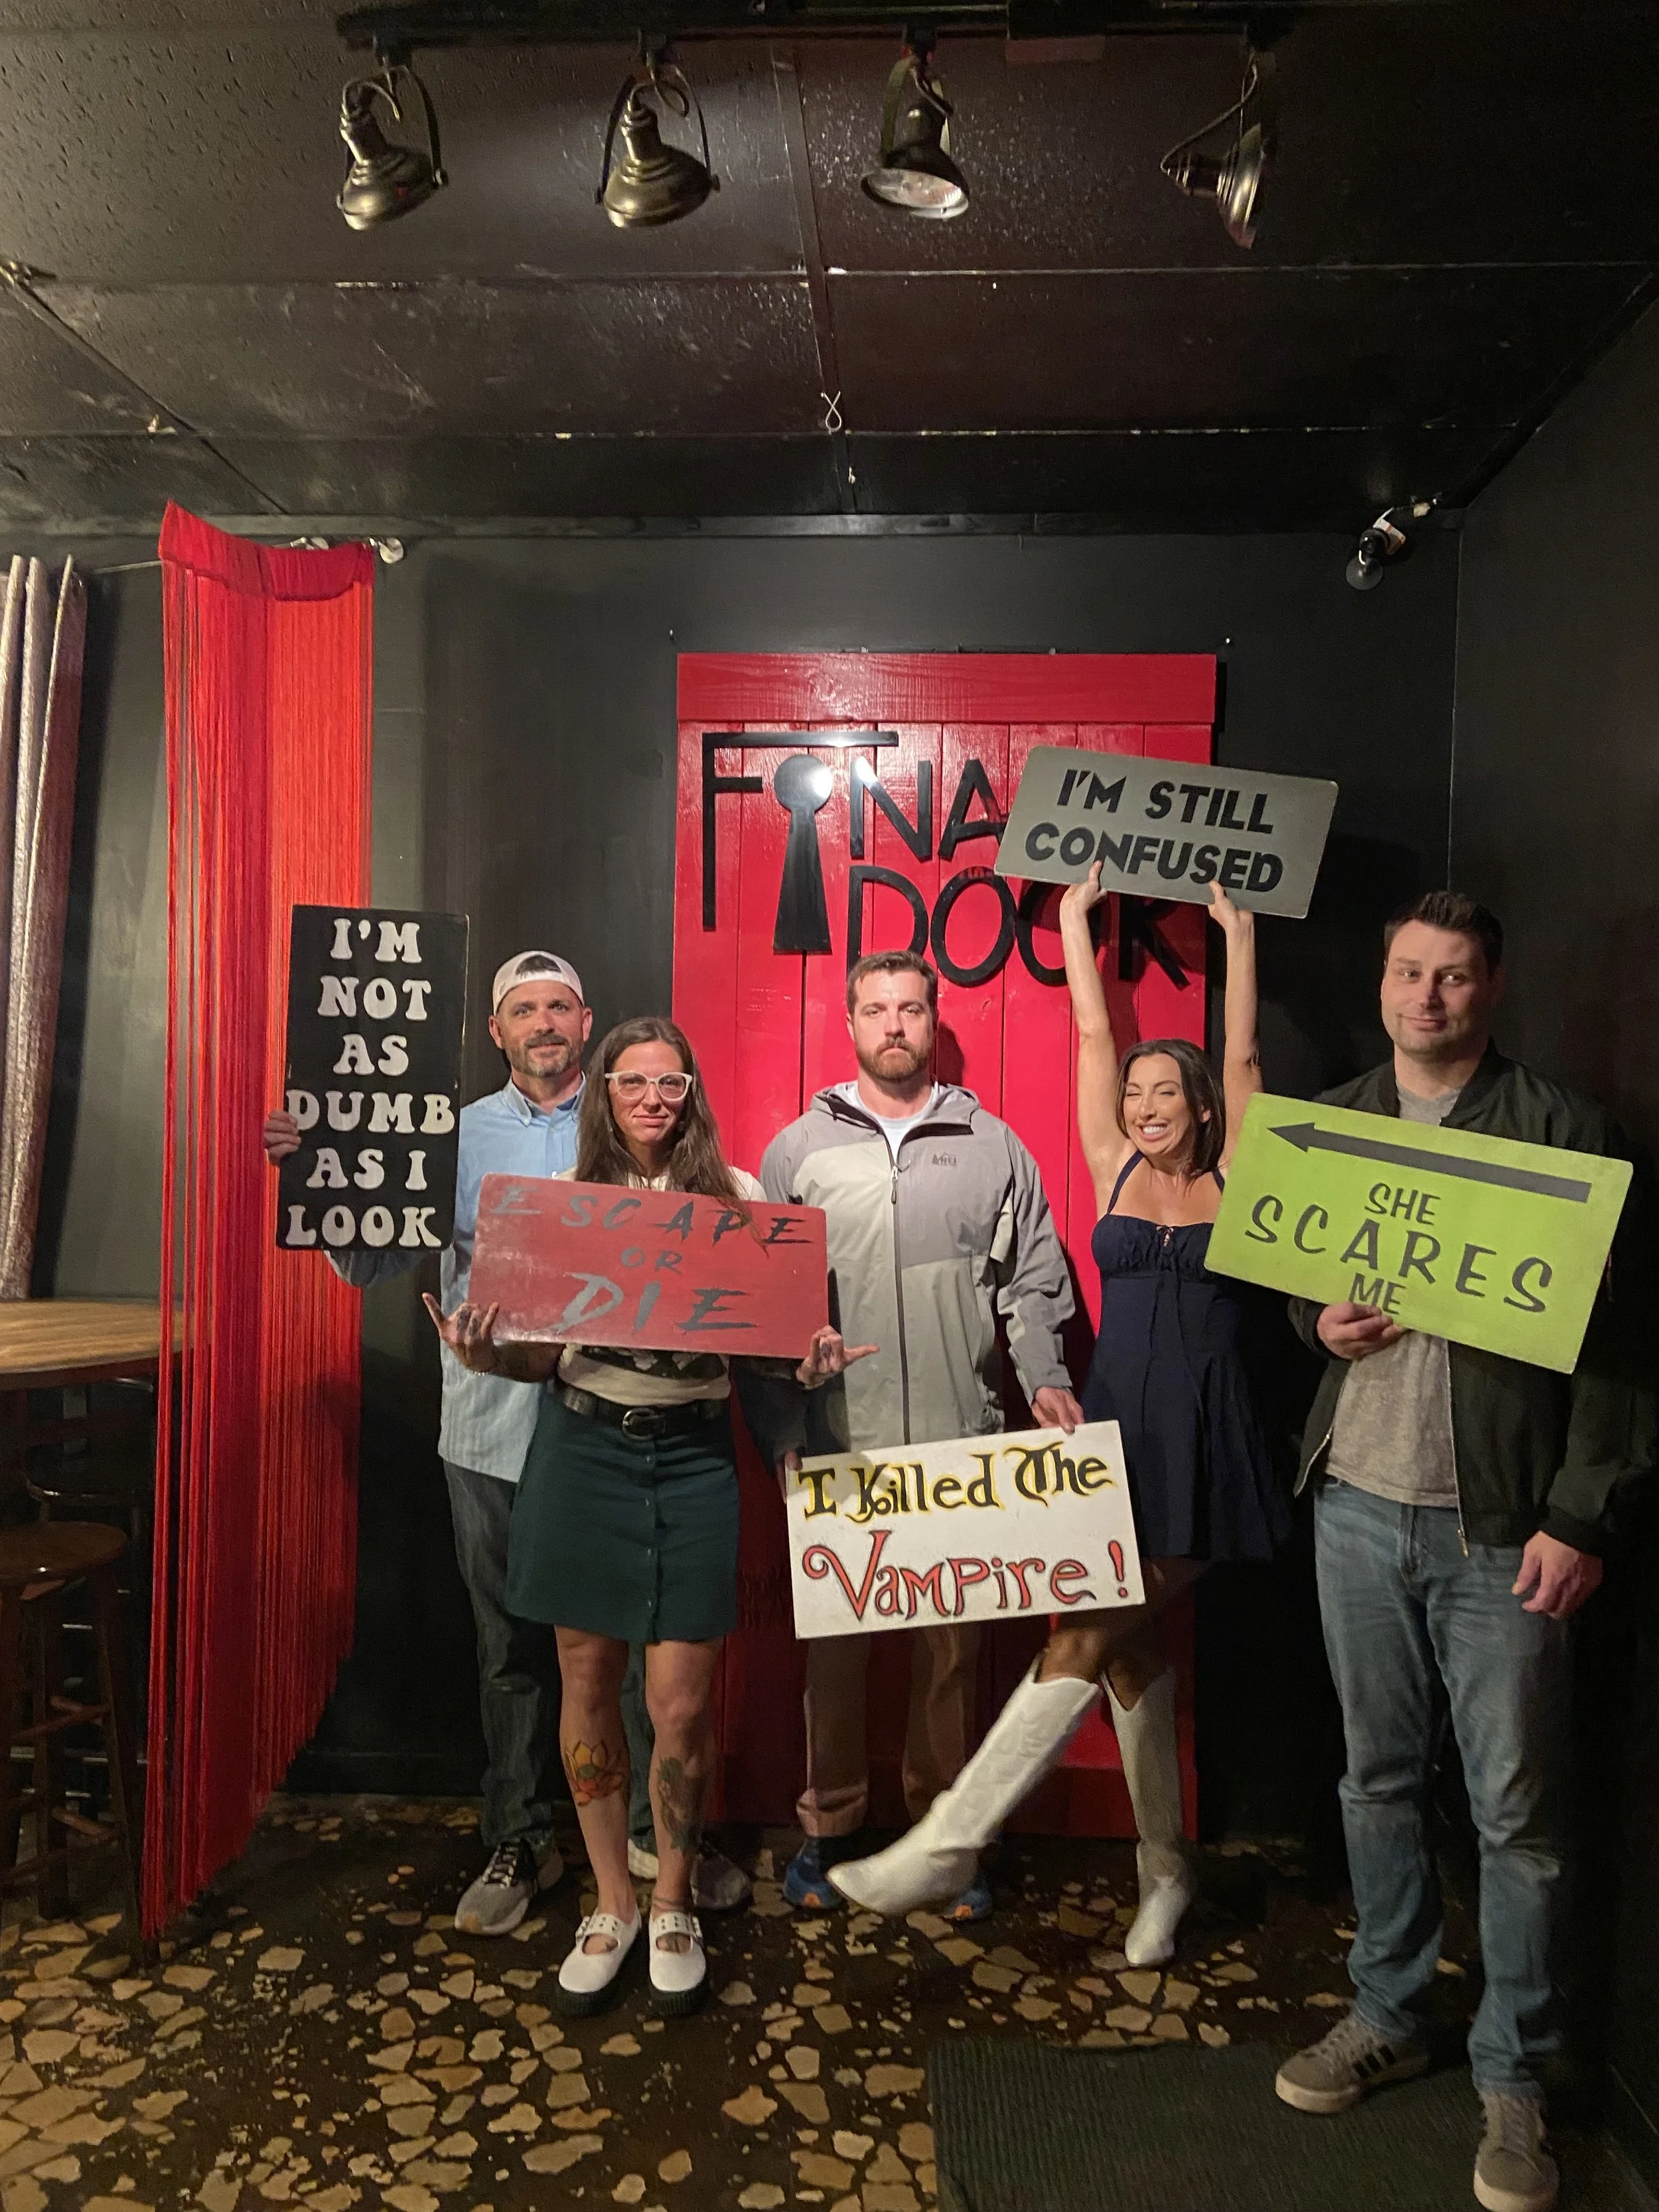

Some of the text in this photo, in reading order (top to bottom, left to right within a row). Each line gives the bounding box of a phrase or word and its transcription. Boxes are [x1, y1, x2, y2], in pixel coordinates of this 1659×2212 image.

[1057, 769, 1273, 834] I'M STILL
[1025, 822, 1283, 893] CONFUSED
[330, 918, 422, 963] I'M
[317, 975, 431, 1021] NOT
[332, 1033, 409, 1076] AS
[285, 1089, 455, 1134] DUMB
[306, 1147, 427, 1191] AS I
[285, 1205, 441, 1247] LOOK
[490, 1184, 814, 1246] ESCAPE
[1364, 1183, 1441, 1226] SHE
[620, 1246, 684, 1274] OR
[1245, 1195, 1553, 1313] SCARES
[548, 1272, 758, 1335] DIE
[1348, 1273, 1406, 1314] ME
[798, 1441, 1114, 1522] I Killed The
